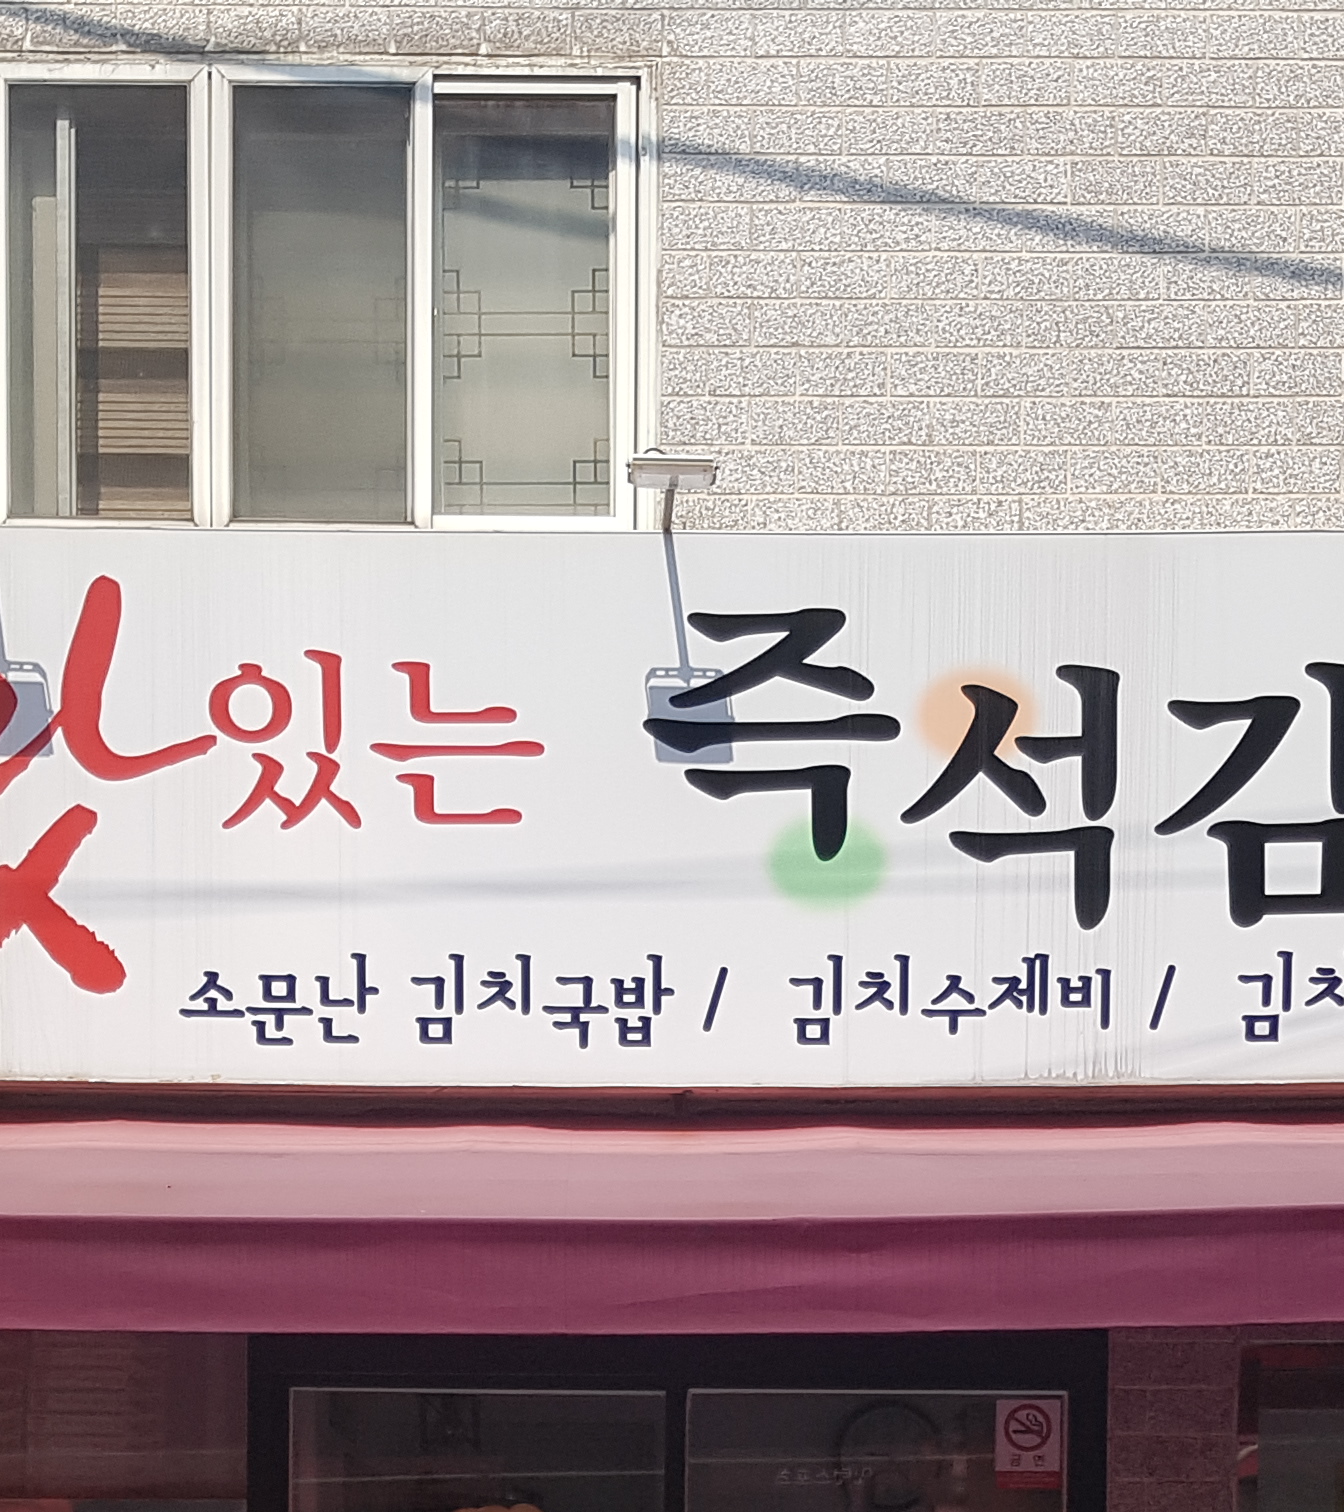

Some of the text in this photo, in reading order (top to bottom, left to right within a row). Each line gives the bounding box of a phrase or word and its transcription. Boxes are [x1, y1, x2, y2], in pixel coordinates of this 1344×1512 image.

[179, 952, 379, 1045] 소문난
[411, 953, 674, 1048] 김치국밥
[789, 953, 1112, 1045] 김치수제비
